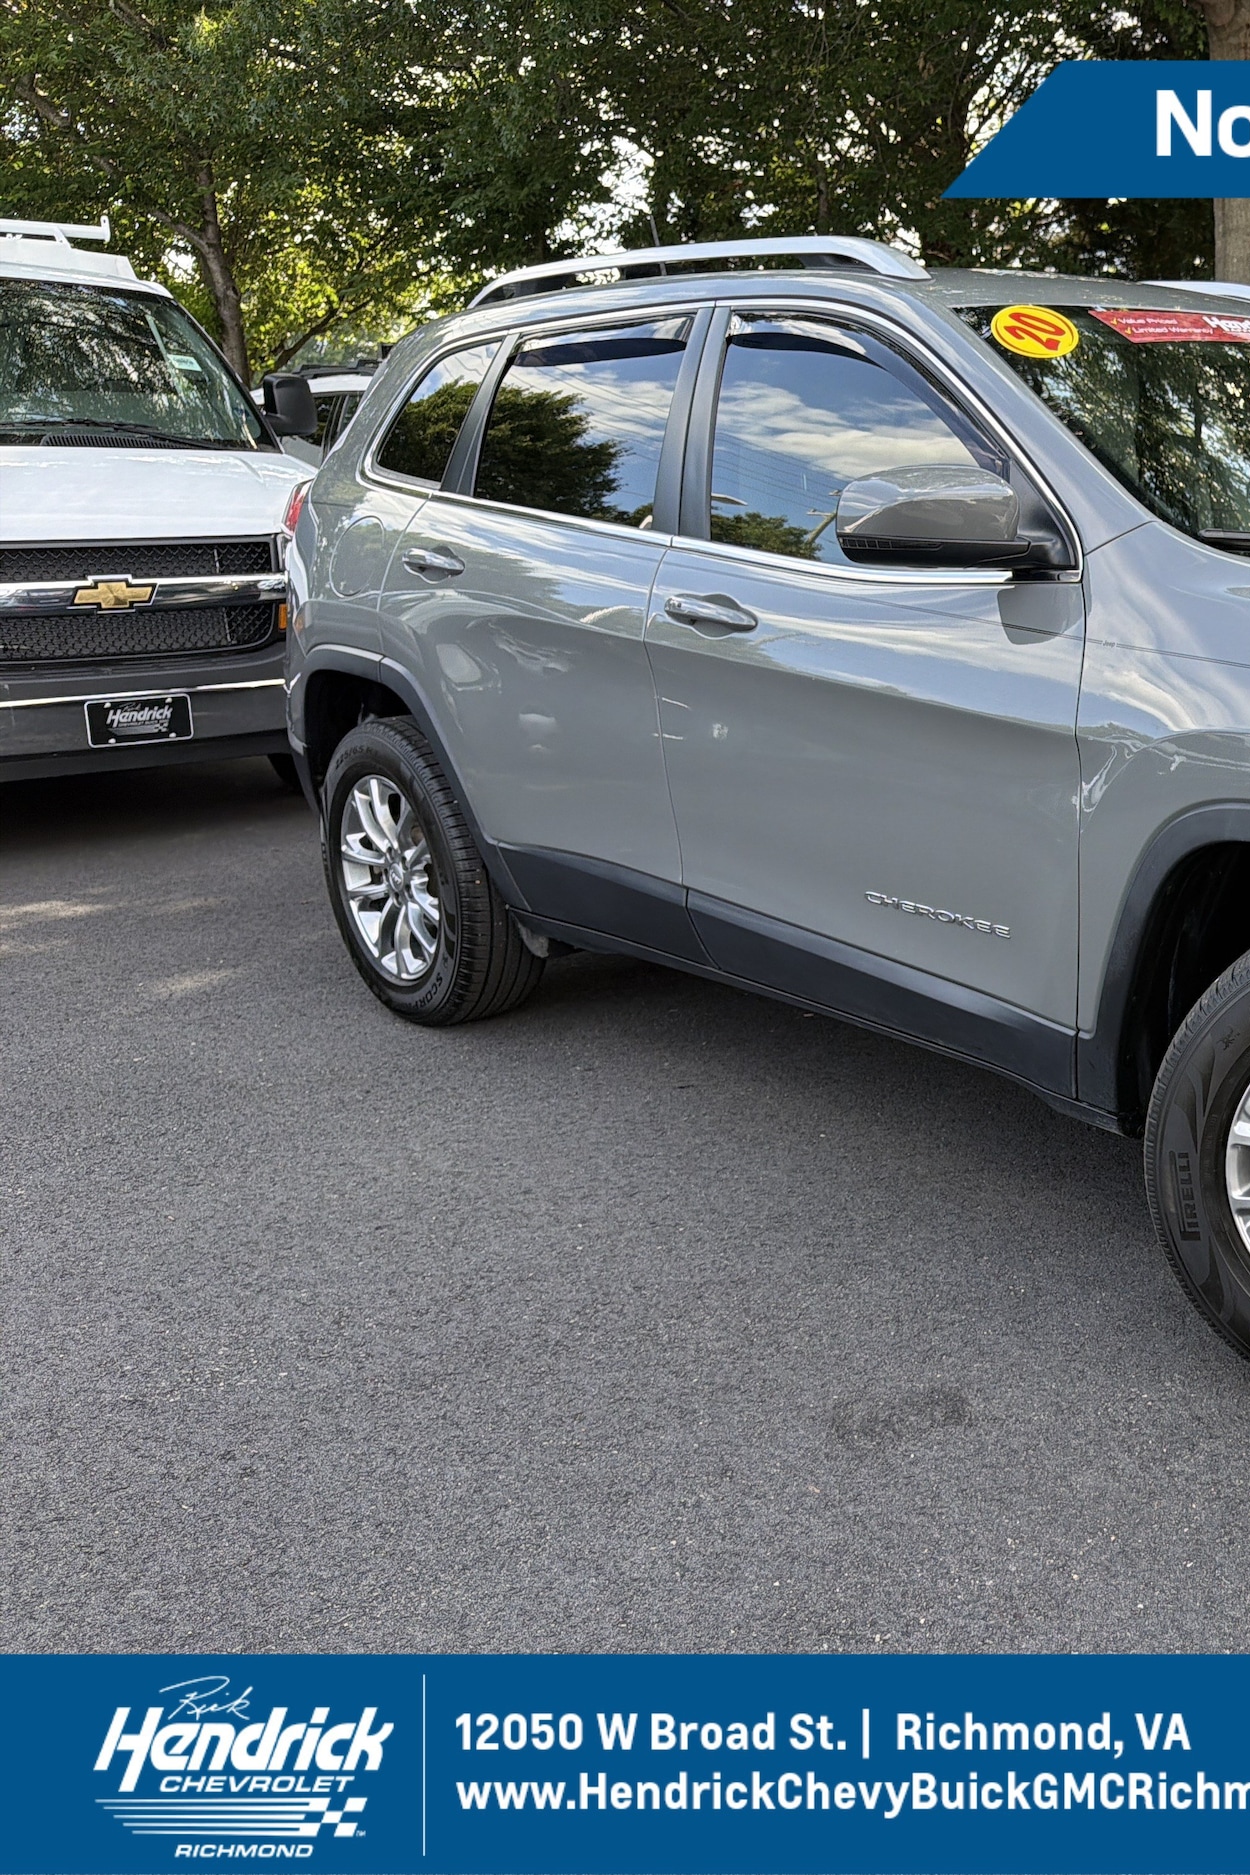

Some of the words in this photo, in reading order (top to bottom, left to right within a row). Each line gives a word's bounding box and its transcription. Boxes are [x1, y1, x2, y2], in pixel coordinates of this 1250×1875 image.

[1004, 312, 1066, 351] 20
[1118, 317, 1145, 326] Value
[1146, 317, 1178, 326] Priced
[1132, 326, 1169, 334] Limited
[1170, 326, 1214, 336] Warranty
[106, 704, 173, 728] Hendrick
[864, 890, 1011, 939] CHEROKEE
[1168, 1150, 1201, 1241] PIRELLI
